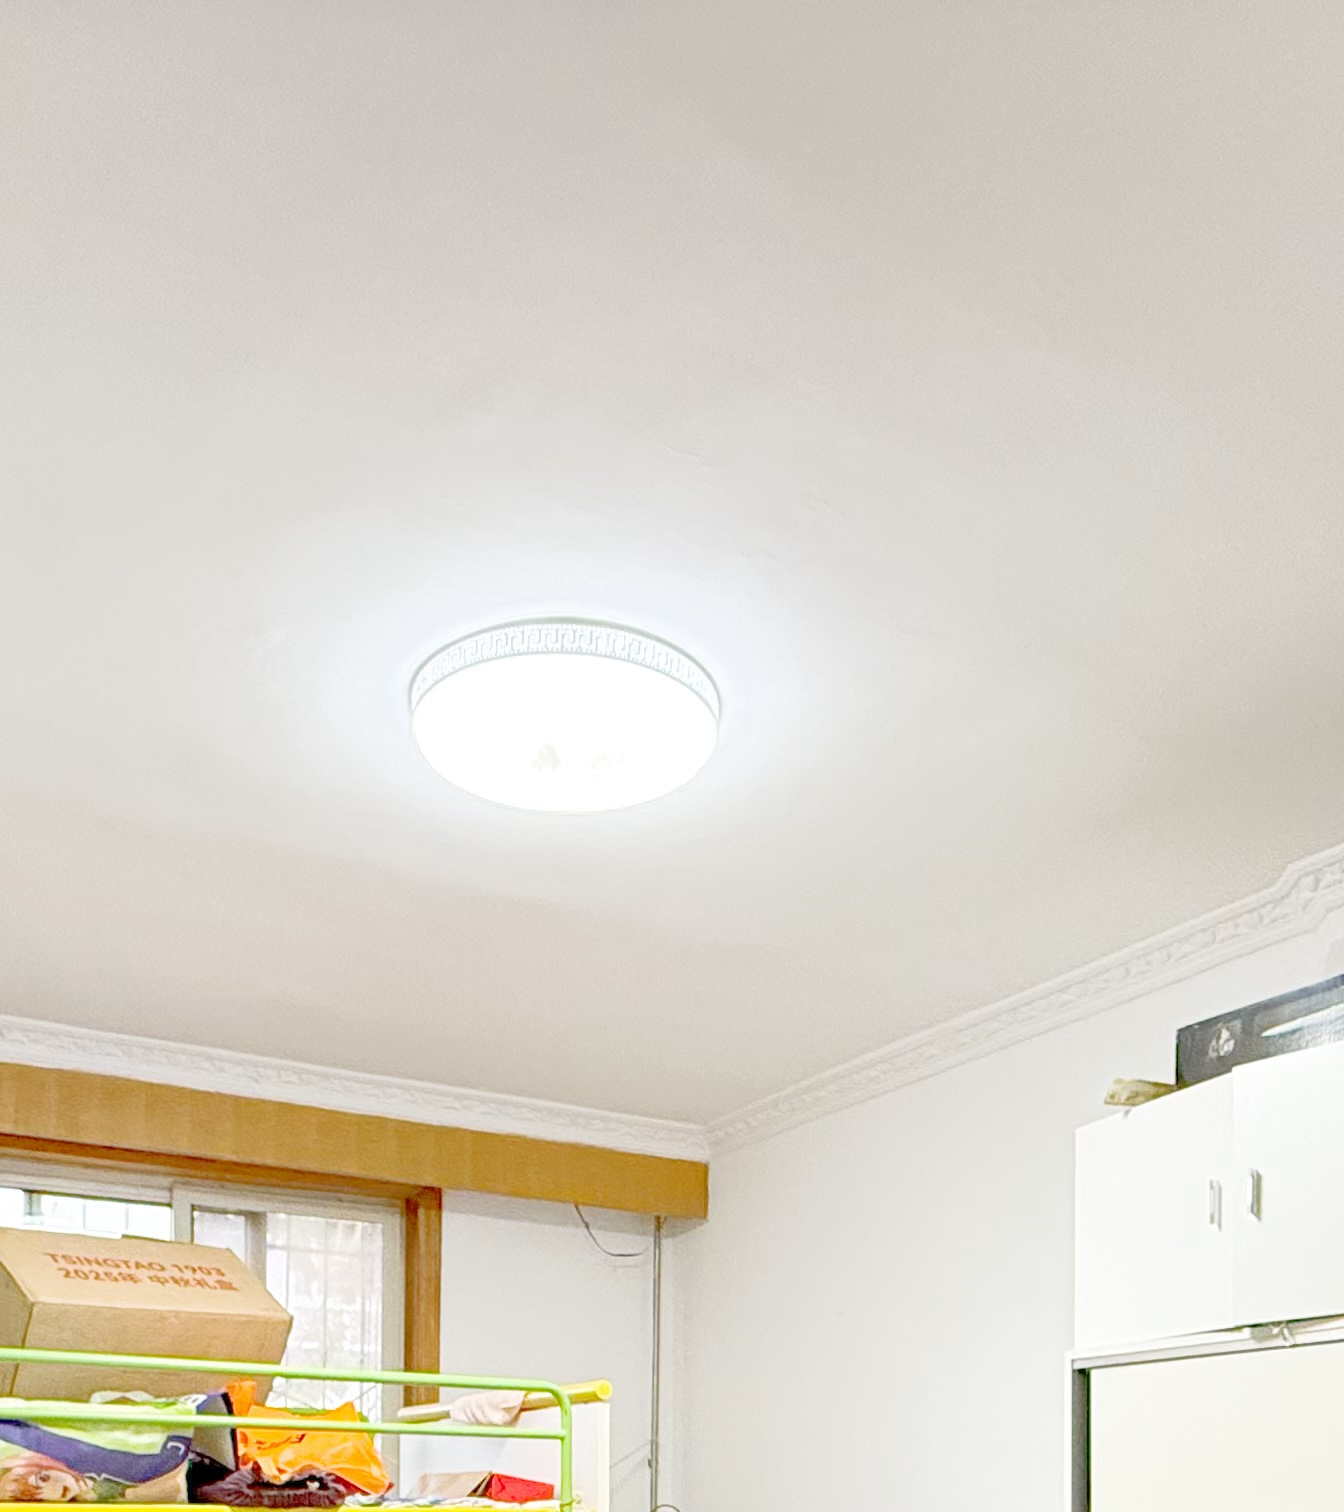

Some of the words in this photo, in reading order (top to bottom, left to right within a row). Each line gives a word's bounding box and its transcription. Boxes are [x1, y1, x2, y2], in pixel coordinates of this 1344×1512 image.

[44, 1252, 166, 1273] TSINGTAO
[172, 1263, 226, 1277] 1903
[57, 1267, 142, 1284] 2025年
[147, 1274, 240, 1292] 中秋礼盒
